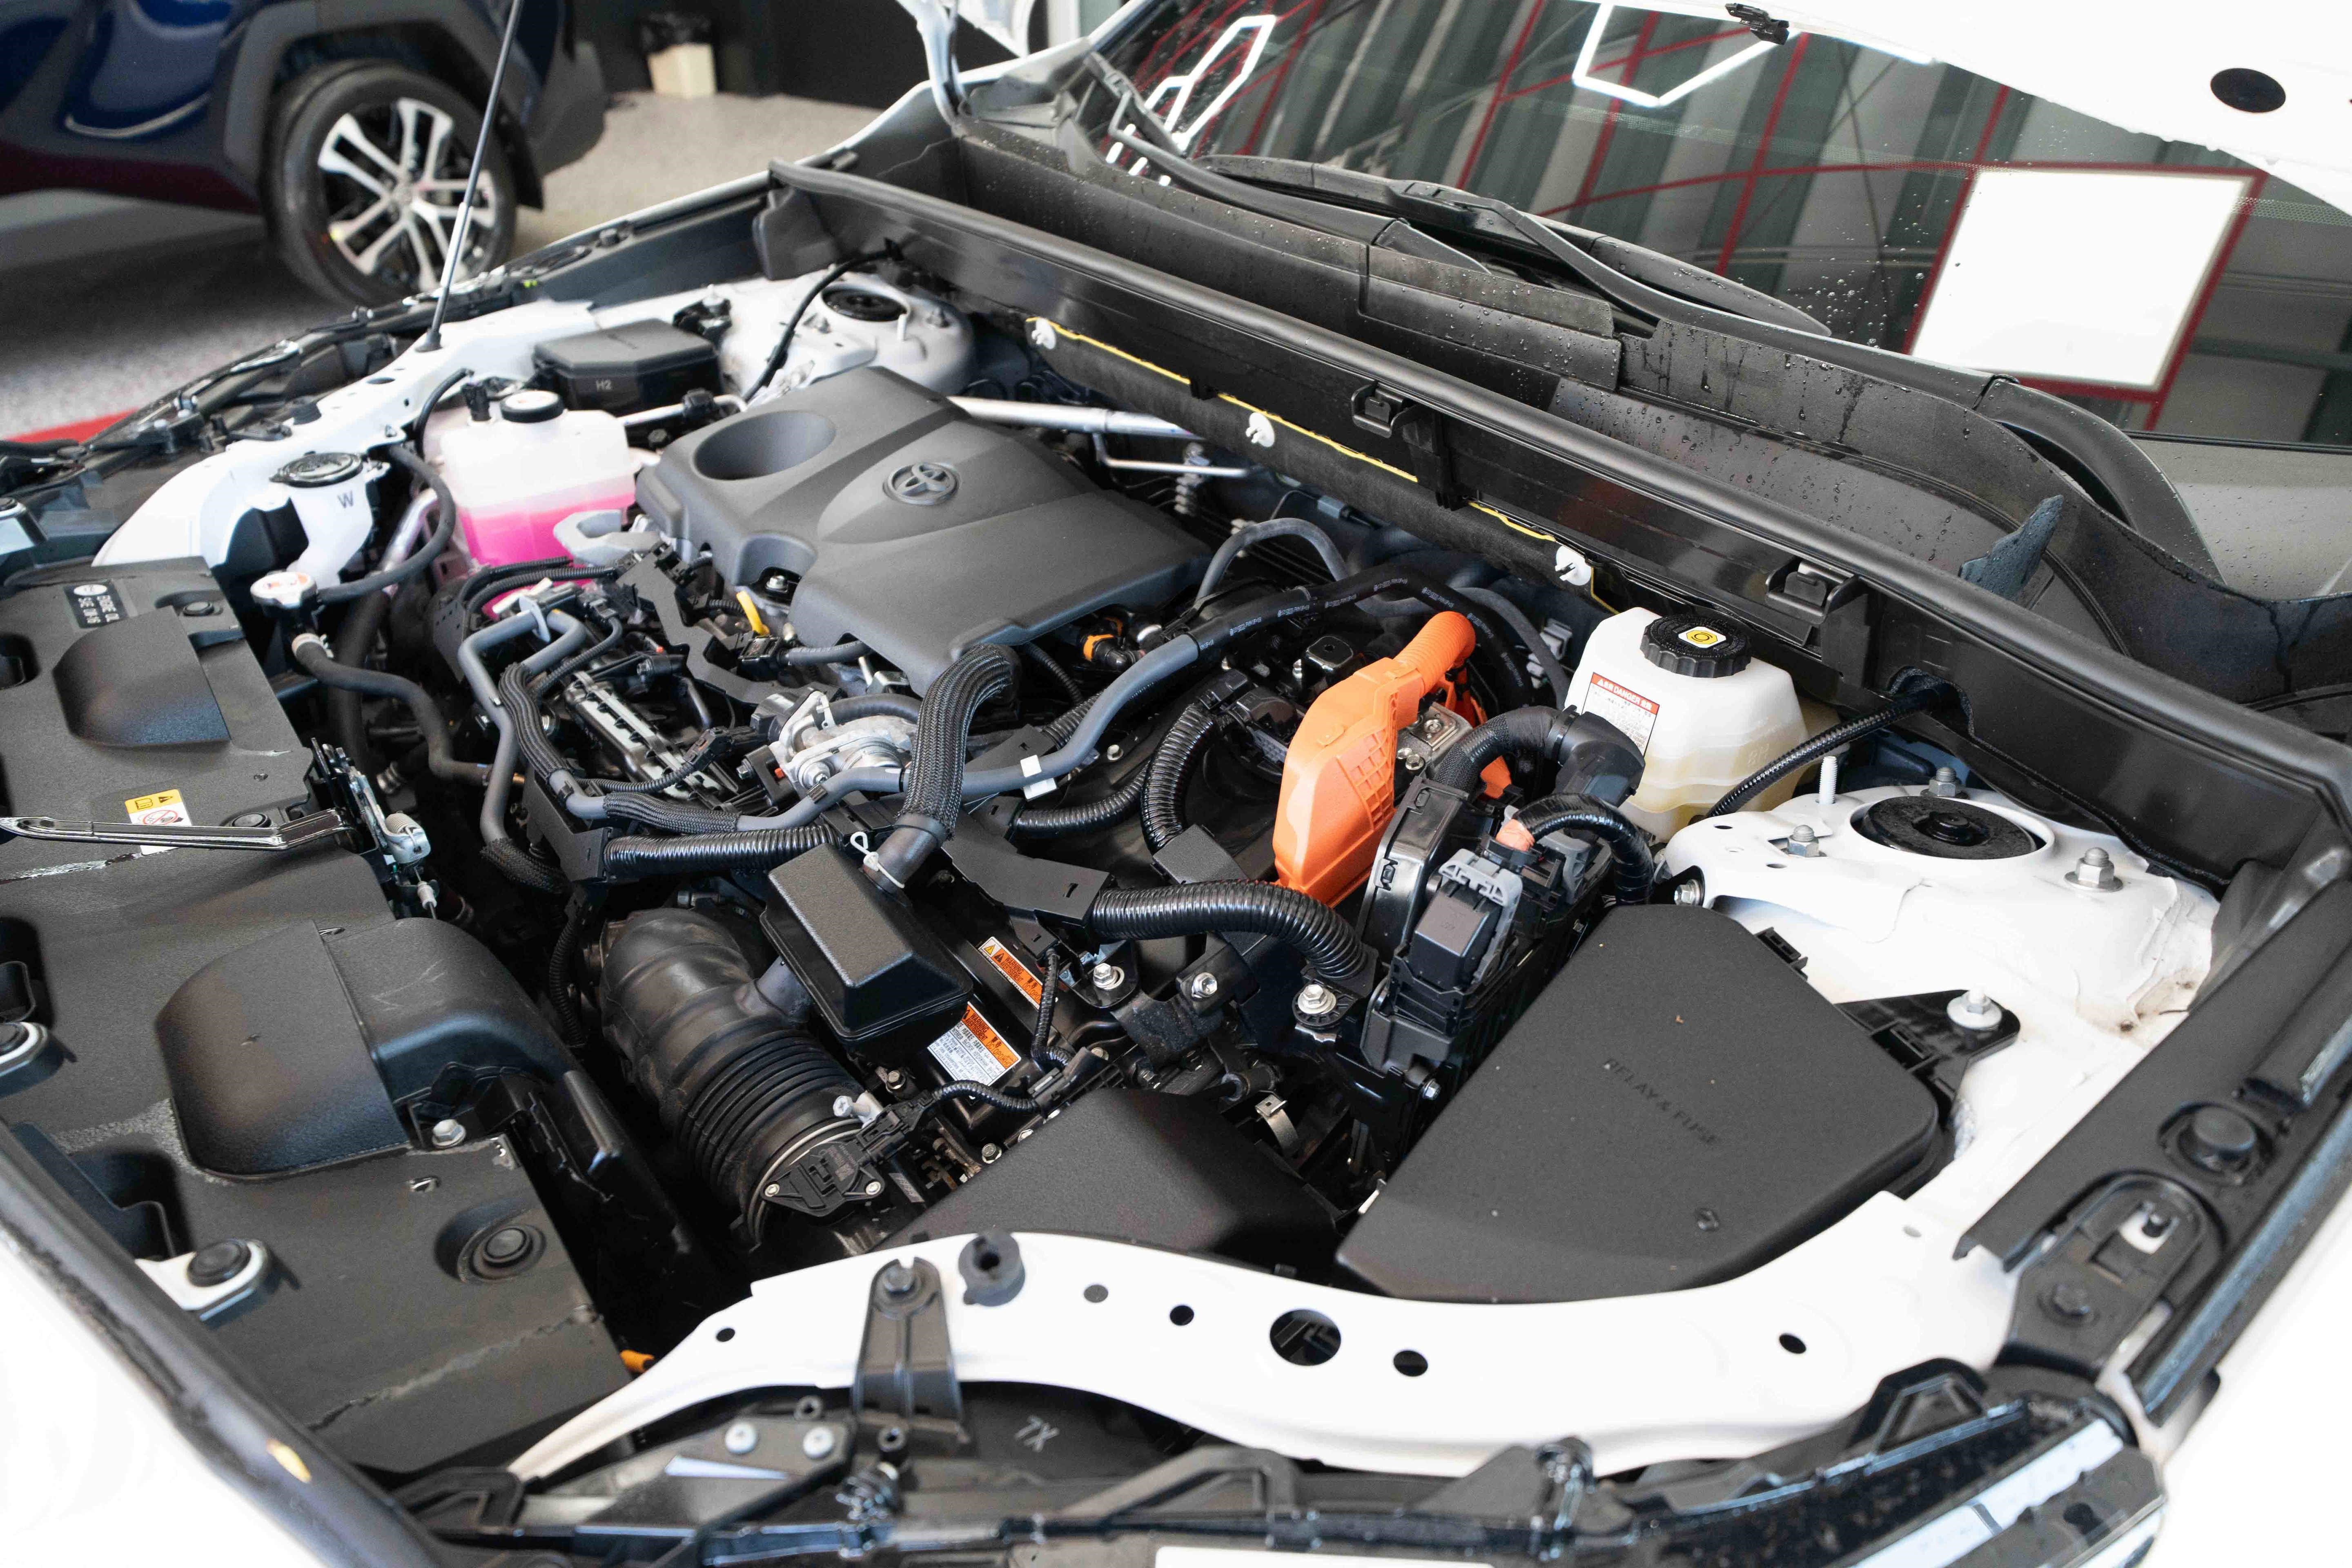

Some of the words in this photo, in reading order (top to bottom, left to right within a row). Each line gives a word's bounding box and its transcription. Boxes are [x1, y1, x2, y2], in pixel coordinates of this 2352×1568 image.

[596, 379, 611, 390] H2
[337, 491, 353, 508] W
[1613, 686, 1640, 704] DANGER
[1005, 956, 1024, 975] WARNING
[970, 1013, 989, 1033] WARNING
